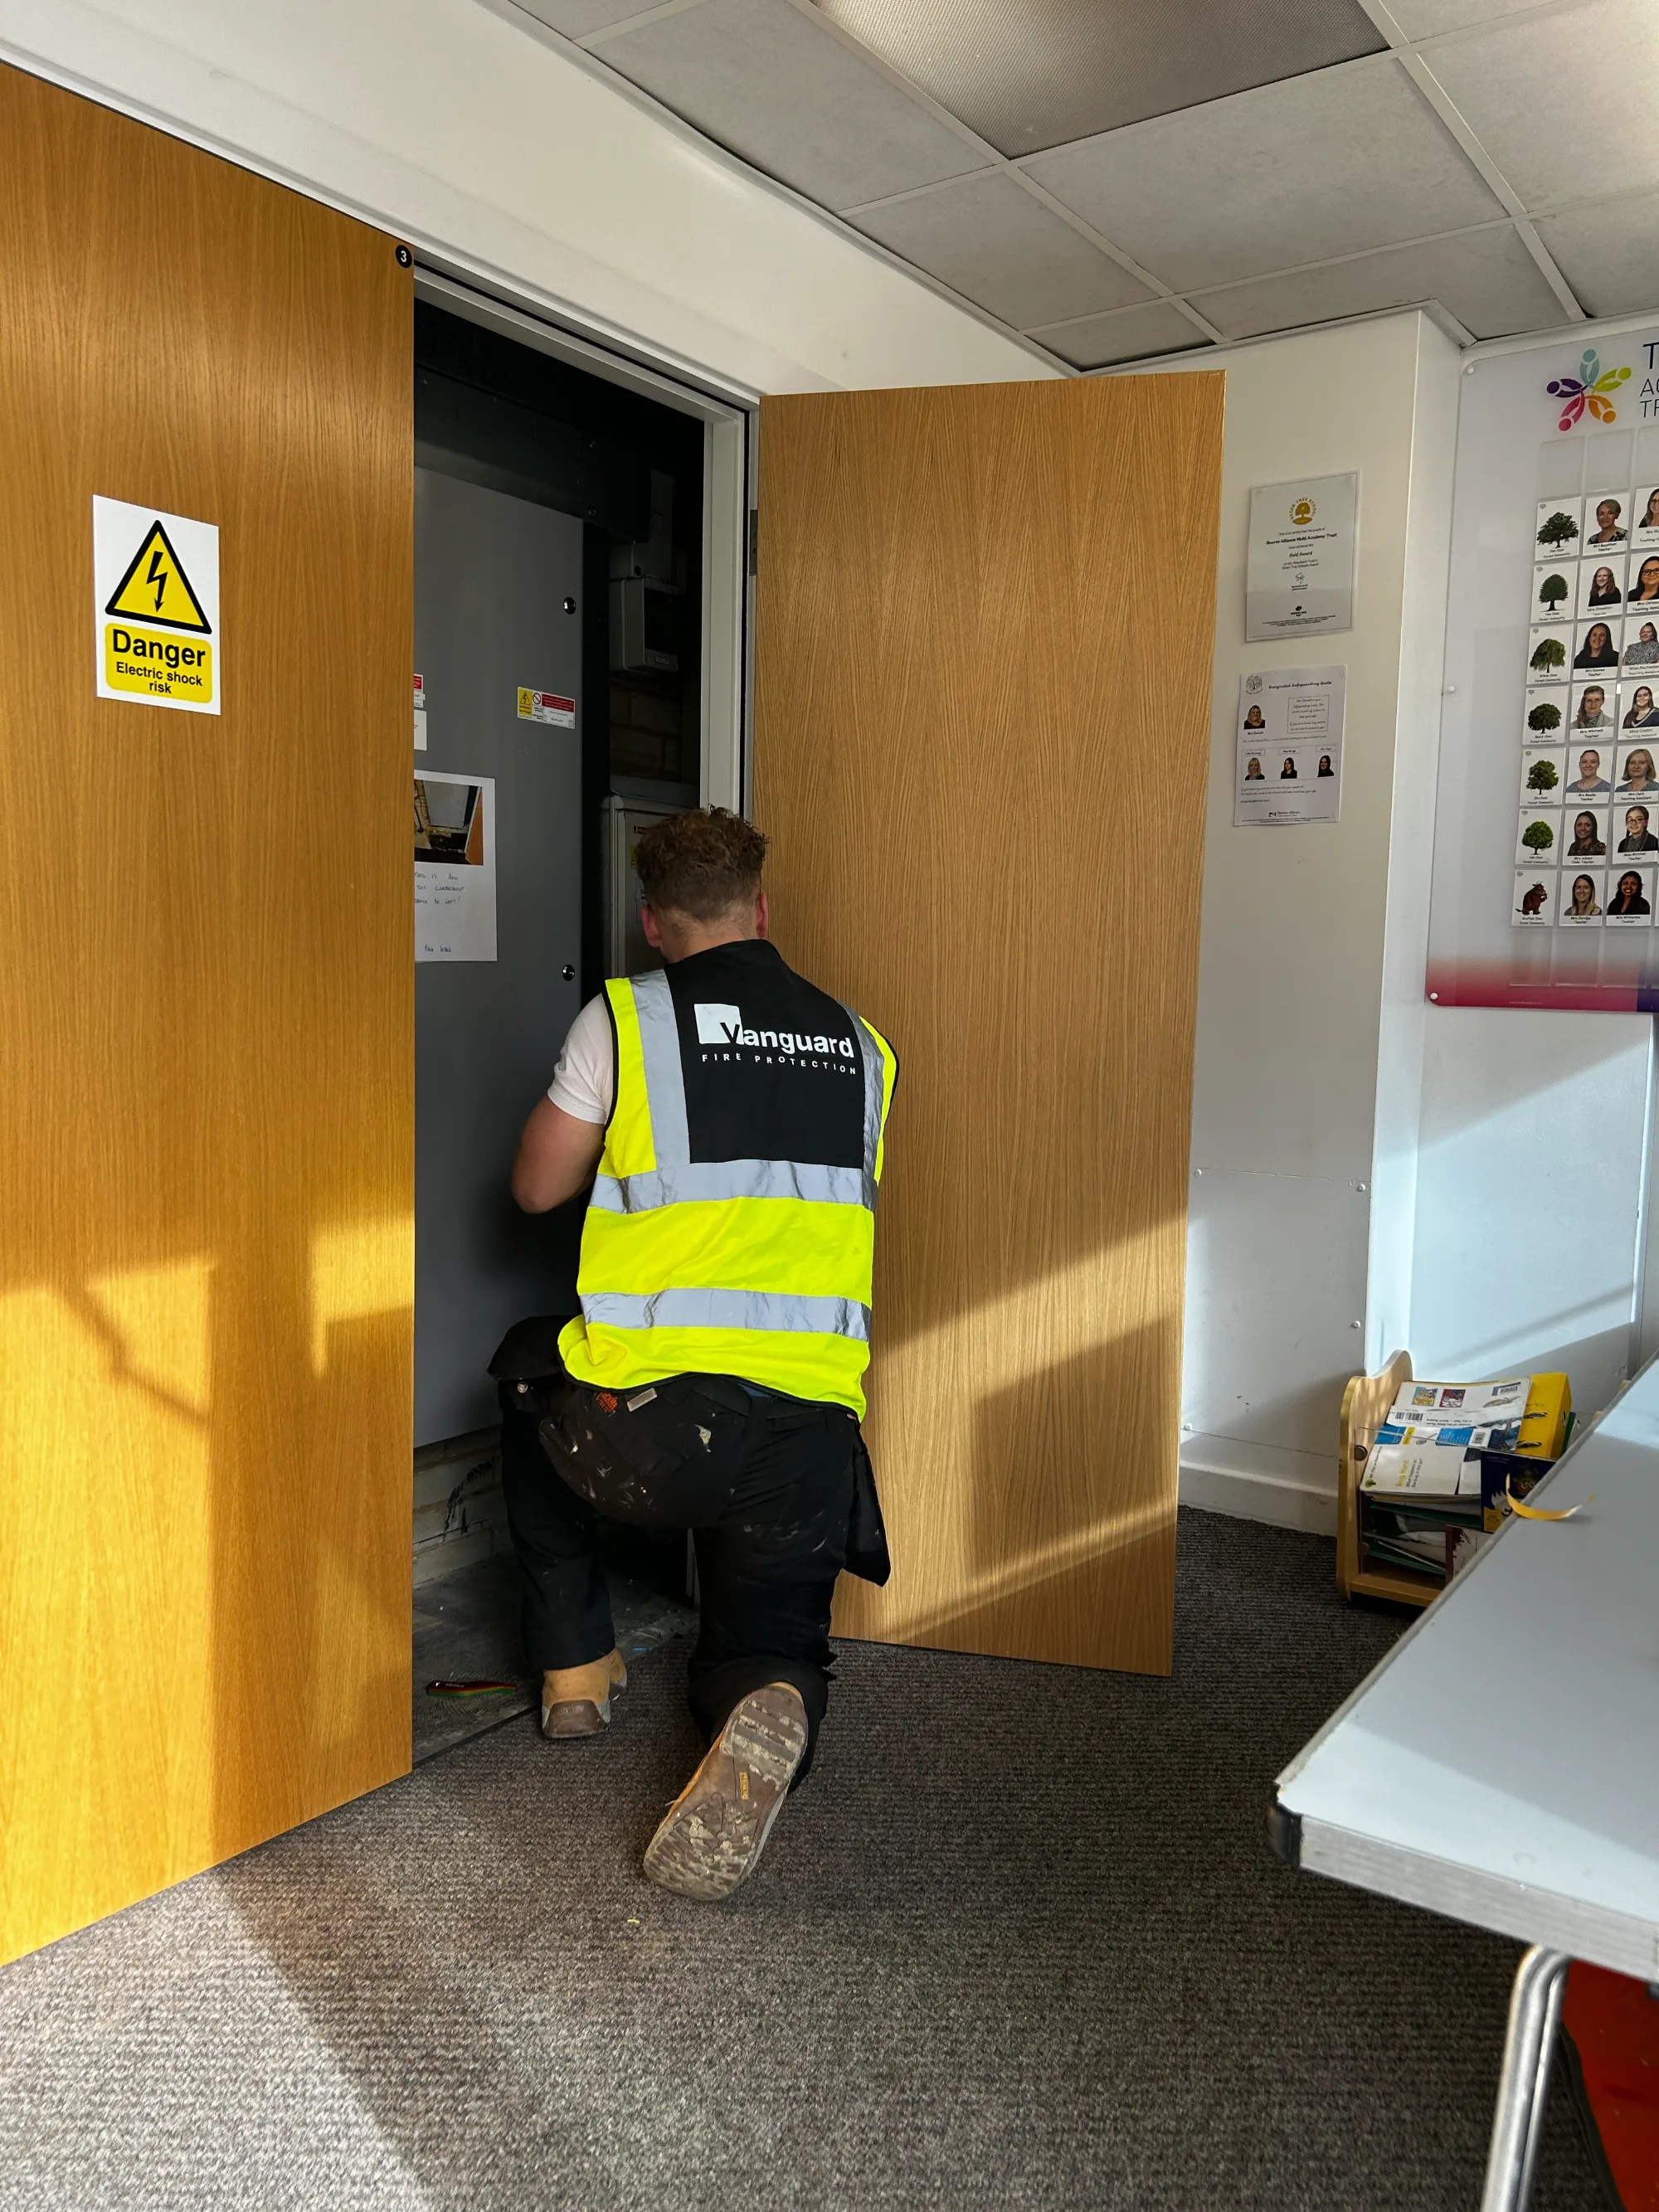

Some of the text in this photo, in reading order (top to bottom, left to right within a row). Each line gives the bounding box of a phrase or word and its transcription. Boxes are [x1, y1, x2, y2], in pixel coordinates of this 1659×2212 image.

[400, 250, 407, 263] 3
[113, 628, 206, 669] Danger
[116, 661, 203, 687] Electric shock
[149, 680, 173, 694] risk
[719, 1022, 854, 1058] Vanguard
[702, 1053, 856, 1075] FIRE PROTECTION
